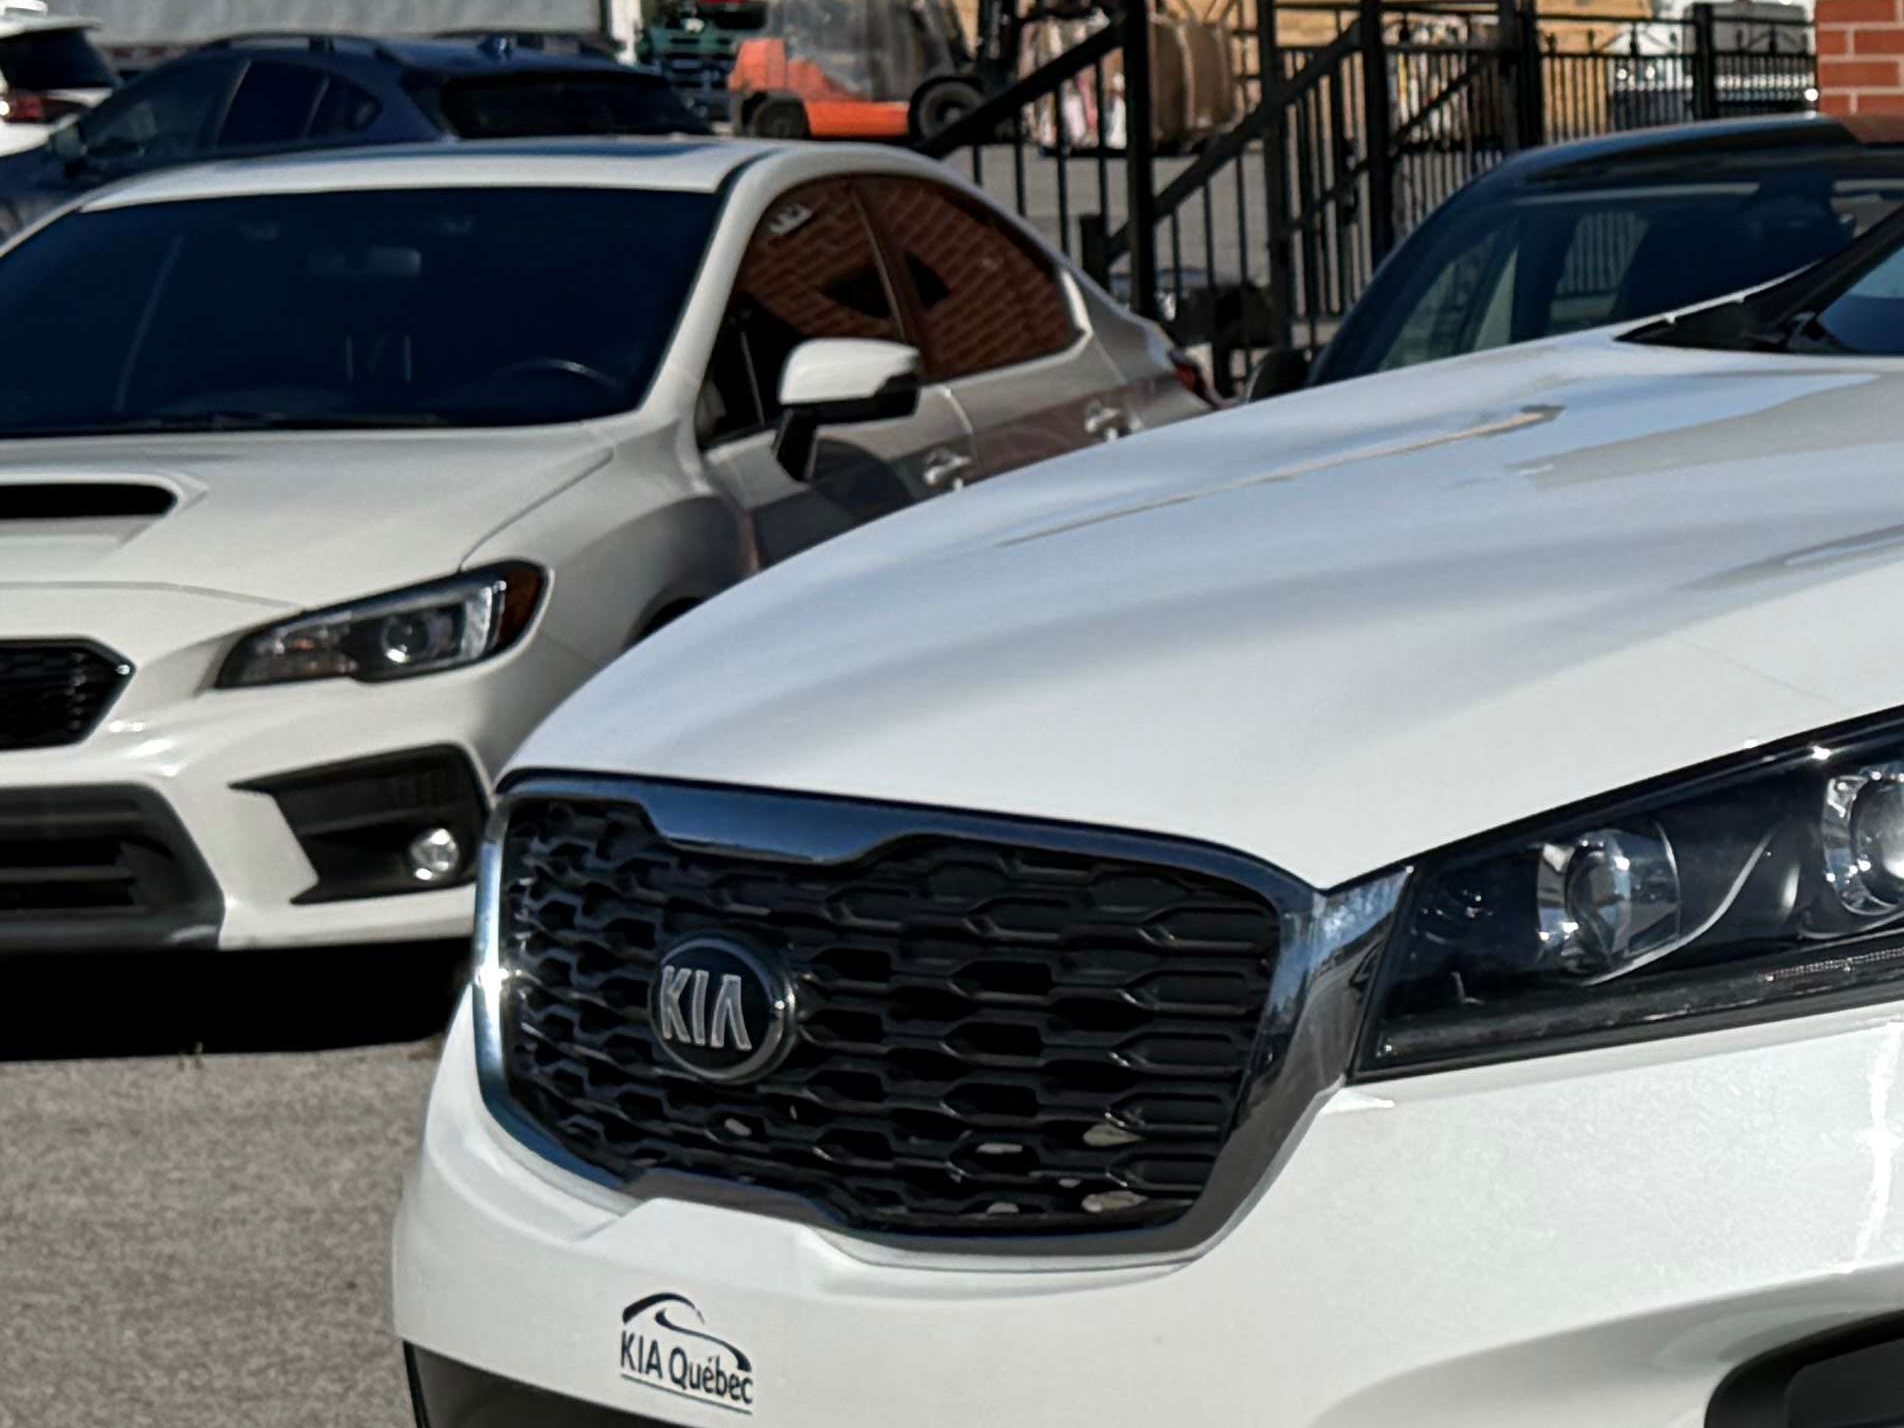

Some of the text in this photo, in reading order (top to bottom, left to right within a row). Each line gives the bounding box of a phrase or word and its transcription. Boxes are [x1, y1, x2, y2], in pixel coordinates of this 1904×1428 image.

[660, 965, 752, 1051] KIA
[620, 1330, 753, 1405] KIA Québec
